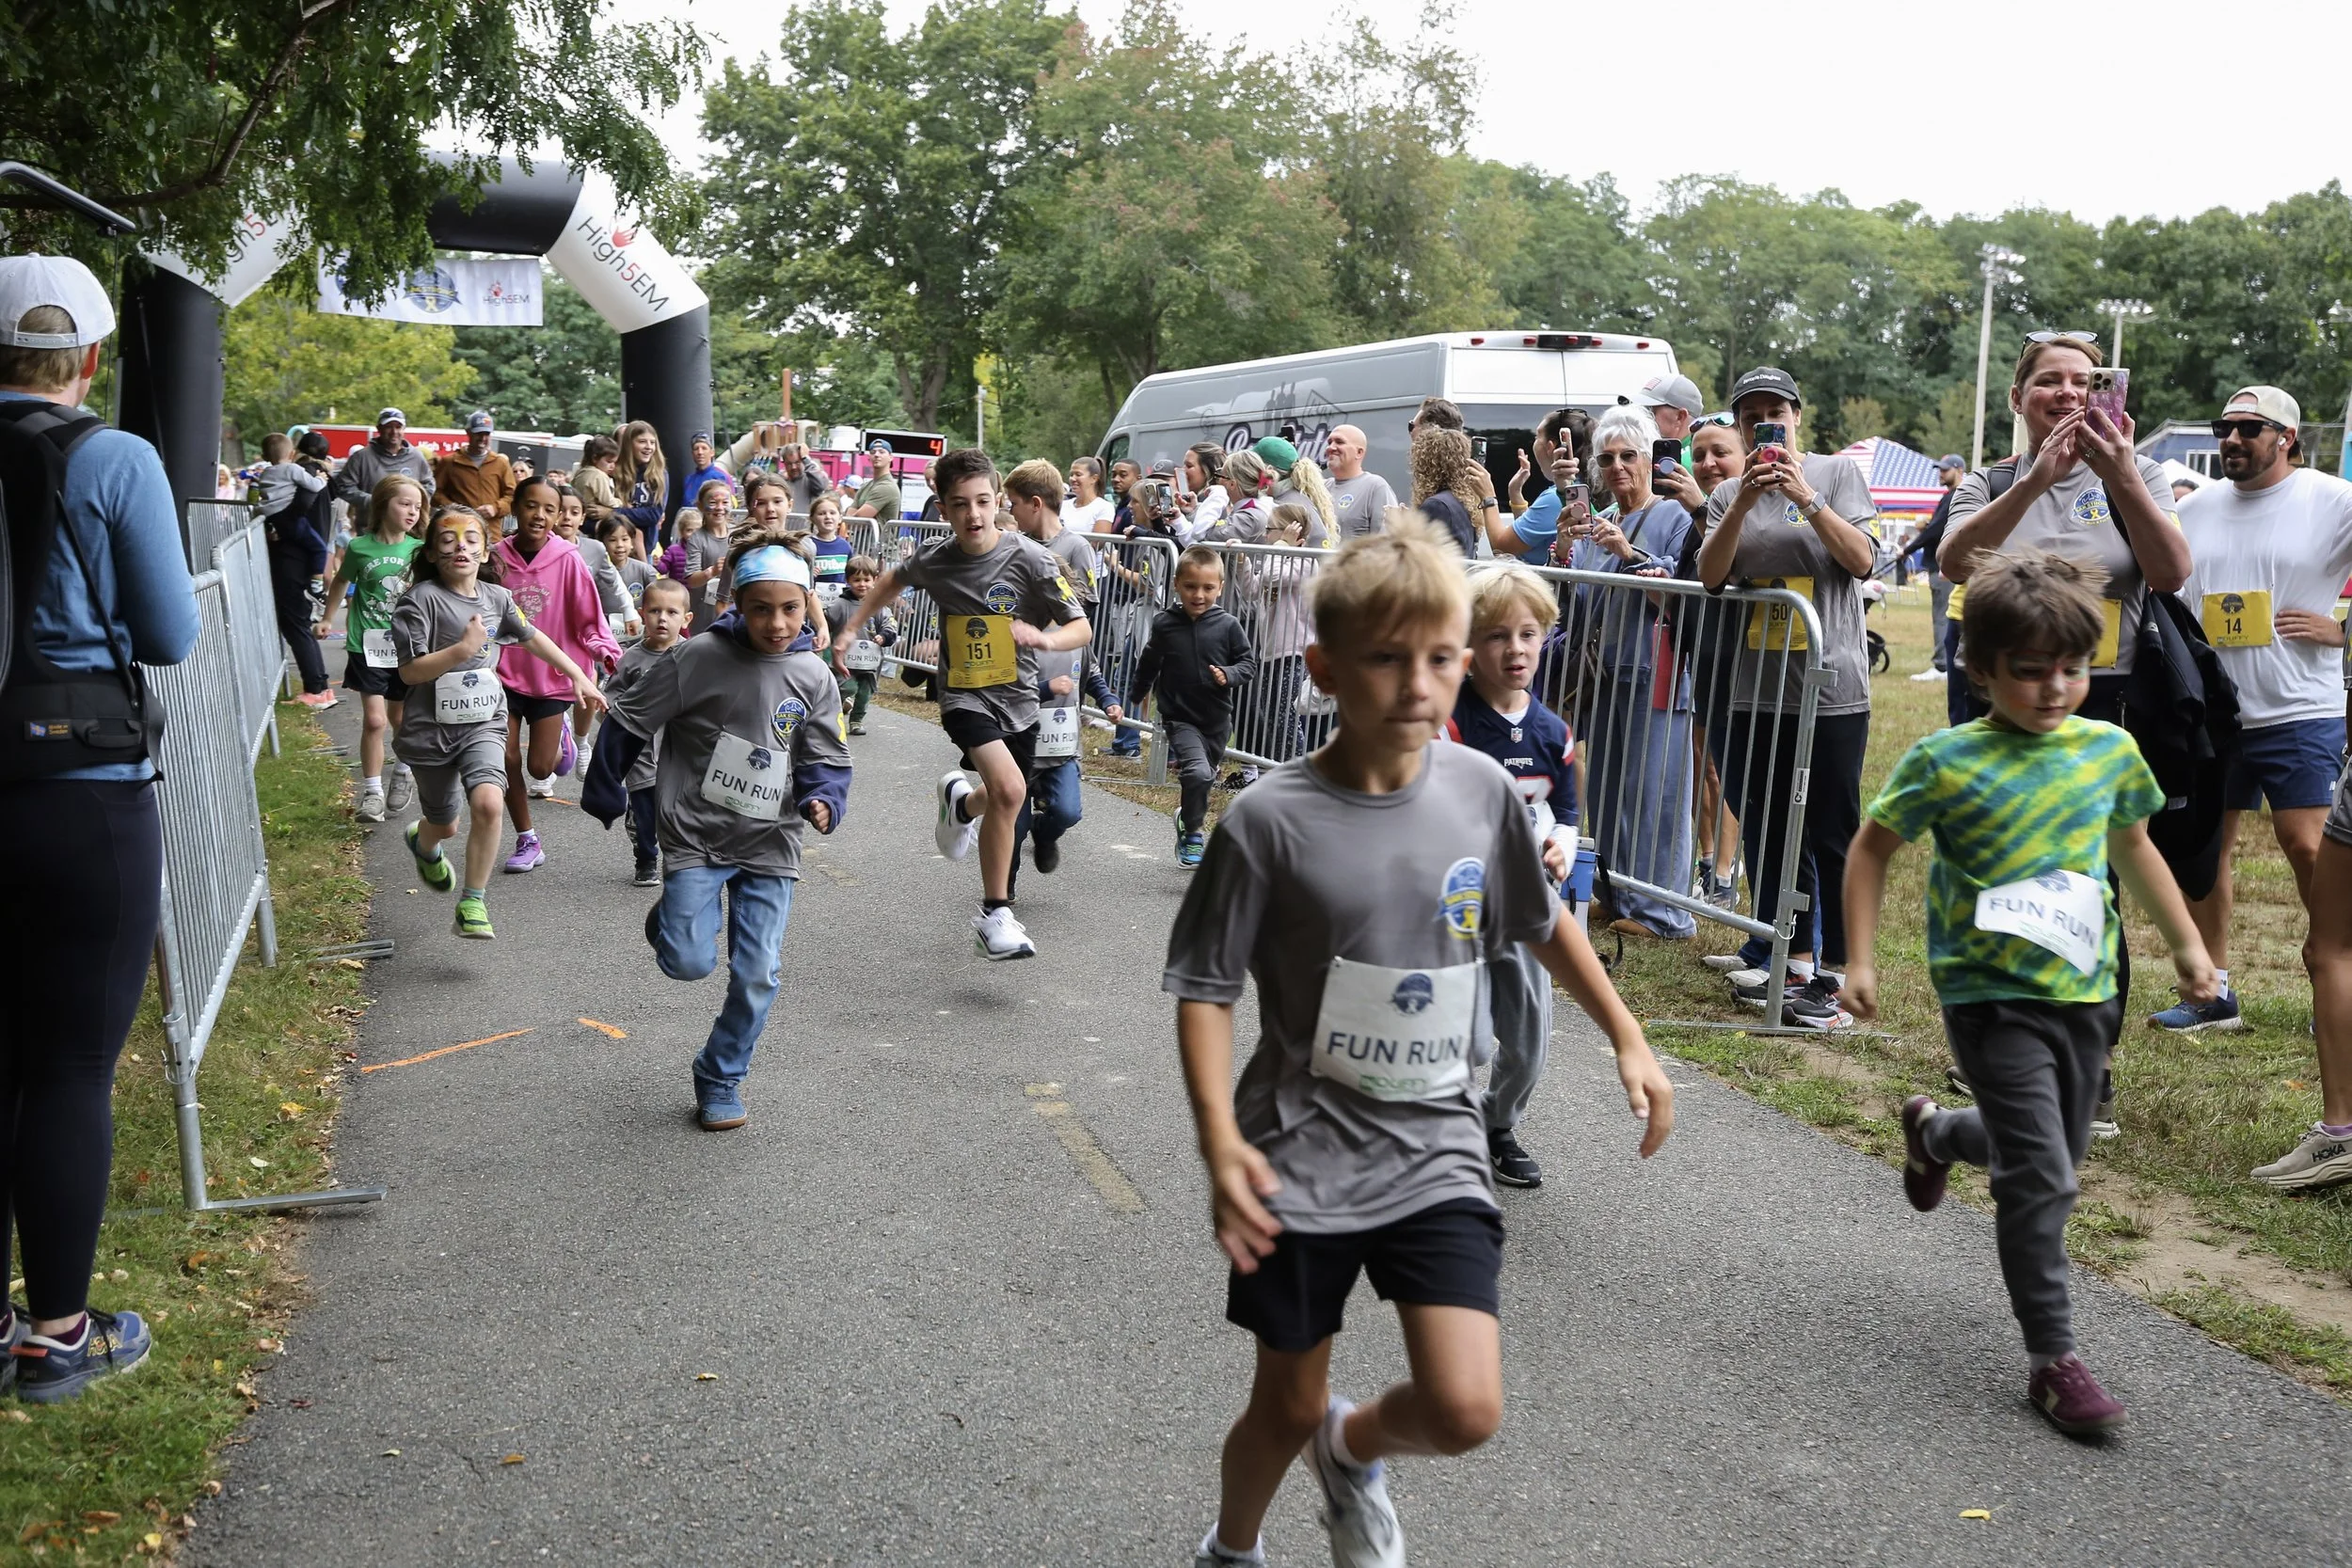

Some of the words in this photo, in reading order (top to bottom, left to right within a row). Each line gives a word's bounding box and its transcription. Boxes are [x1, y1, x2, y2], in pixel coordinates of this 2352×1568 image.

[577, 216, 670, 312] High5EM
[930, 440, 941, 455] 4
[2224, 617, 2243, 635] 14
[847, 653, 863, 662] FUN
[966, 641, 993, 660] 151
[441, 698, 469, 710] FUN
[473, 693, 498, 708] RUN
[711, 768, 748, 794] FUN
[751, 784, 782, 802] RUN
[1989, 896, 2046, 920] FUN
[2052, 908, 2098, 949] RUN
[1327, 1031, 1398, 1065] FUN
[1406, 1037, 1464, 1066] RUN
[2311, 1143, 2347, 1163] HOKA
